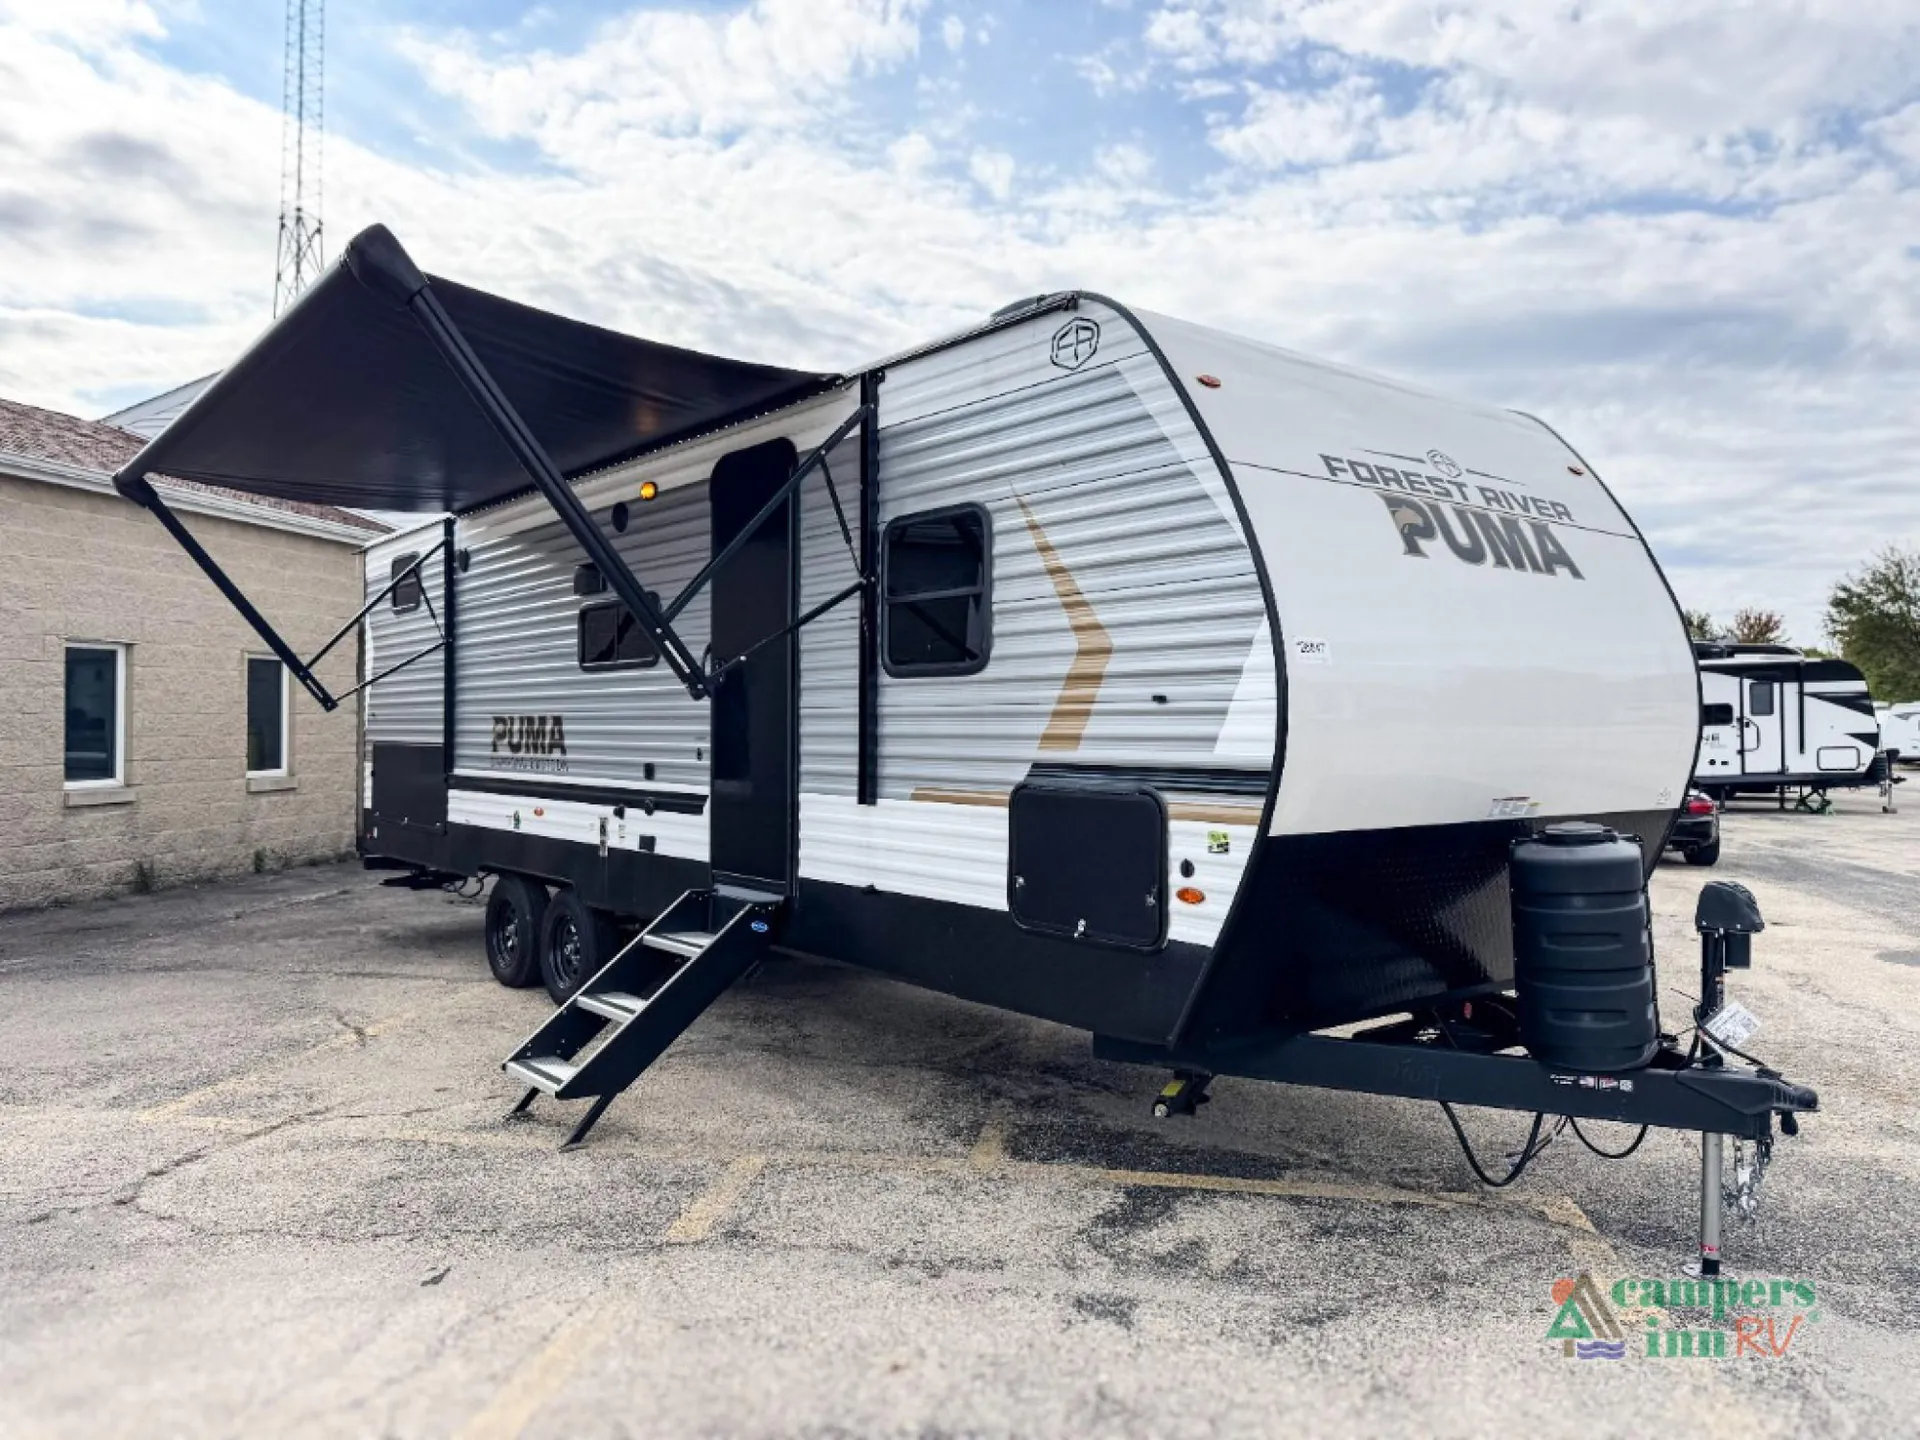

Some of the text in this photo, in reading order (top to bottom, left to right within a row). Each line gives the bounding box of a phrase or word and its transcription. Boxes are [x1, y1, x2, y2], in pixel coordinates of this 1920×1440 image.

[1318, 453, 1468, 502] FOREST
[1476, 485, 1575, 522] RIVER
[1375, 493, 1585, 580] PUMA
[492, 715, 566, 755] PUMA
